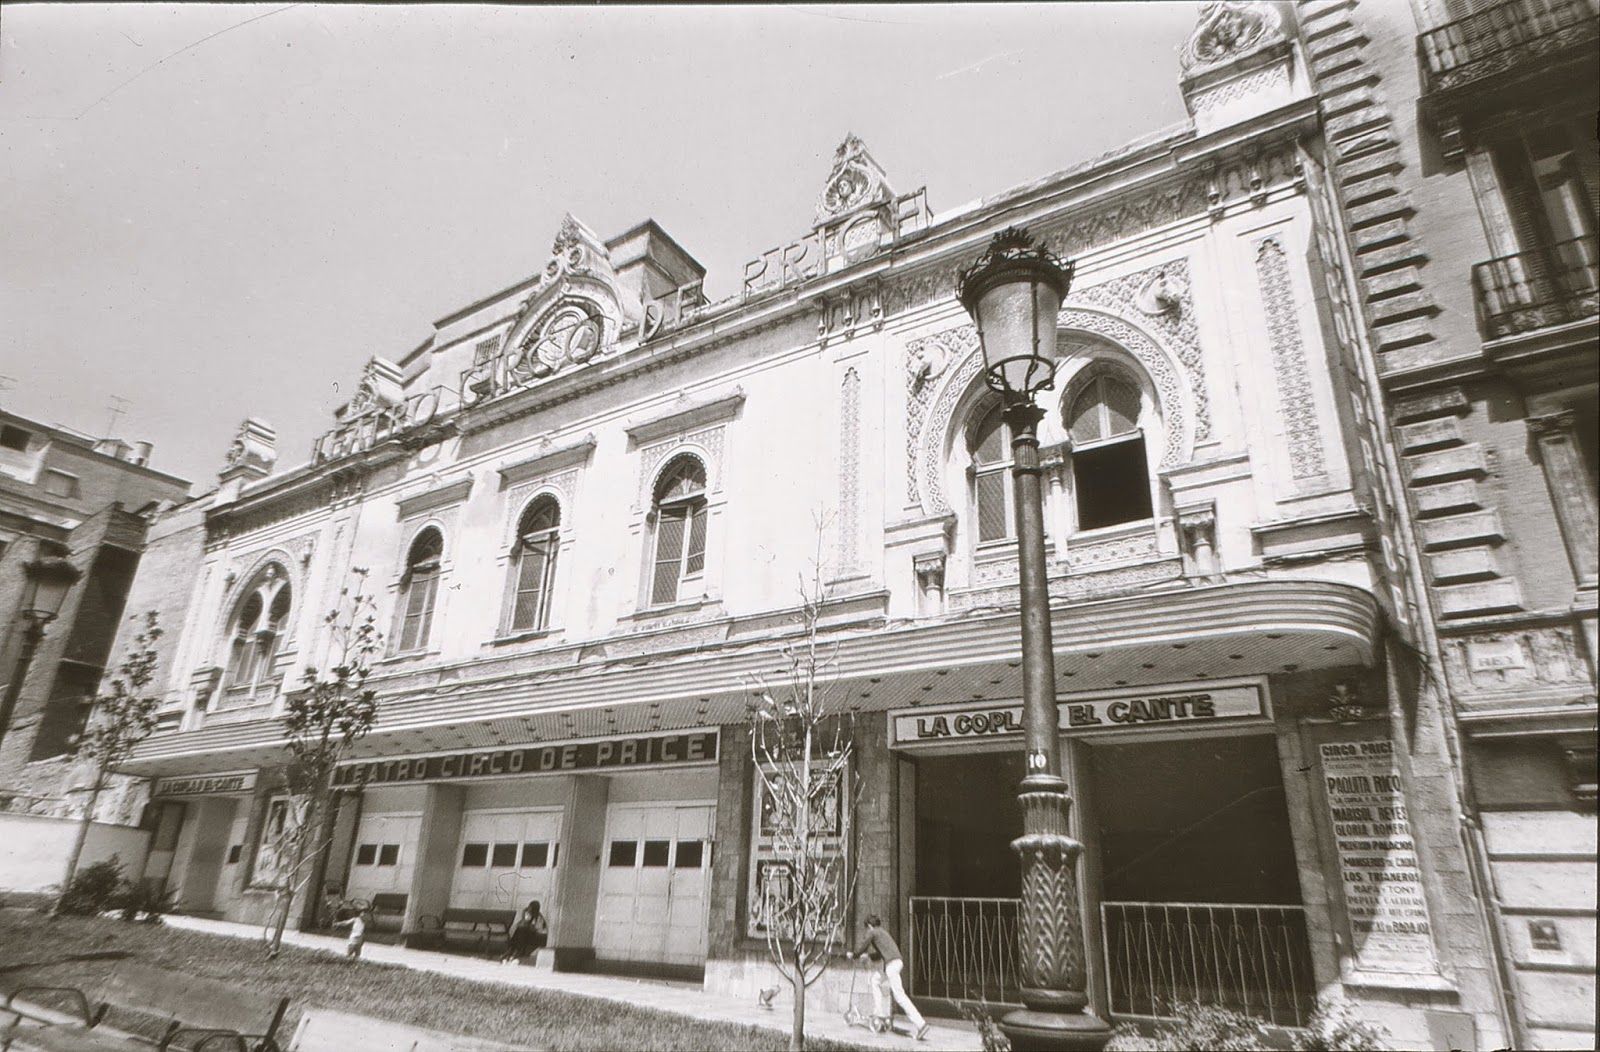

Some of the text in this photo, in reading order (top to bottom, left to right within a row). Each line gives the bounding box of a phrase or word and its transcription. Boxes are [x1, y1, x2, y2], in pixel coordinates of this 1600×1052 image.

[460, 318, 600, 407] CIRCO
[638, 279, 705, 346] DE
[744, 185, 928, 304] PRICE
[917, 716, 951, 737] LA
[954, 710, 1025, 734] COPL
[1068, 705, 1102, 726] EL
[1107, 694, 1215, 722] CANTE
[1321, 744, 1357, 756] CIRCO
[341, 733, 706, 783] TEATRO CIRCO DE PRICE
[1029, 753, 1047, 768] 10
[1327, 774, 1401, 794] PAQUITA RICO
[1335, 823, 1369, 837] GLORIA
[1344, 872, 1362, 882] LOS
[1388, 886, 1416, 895] TONY
